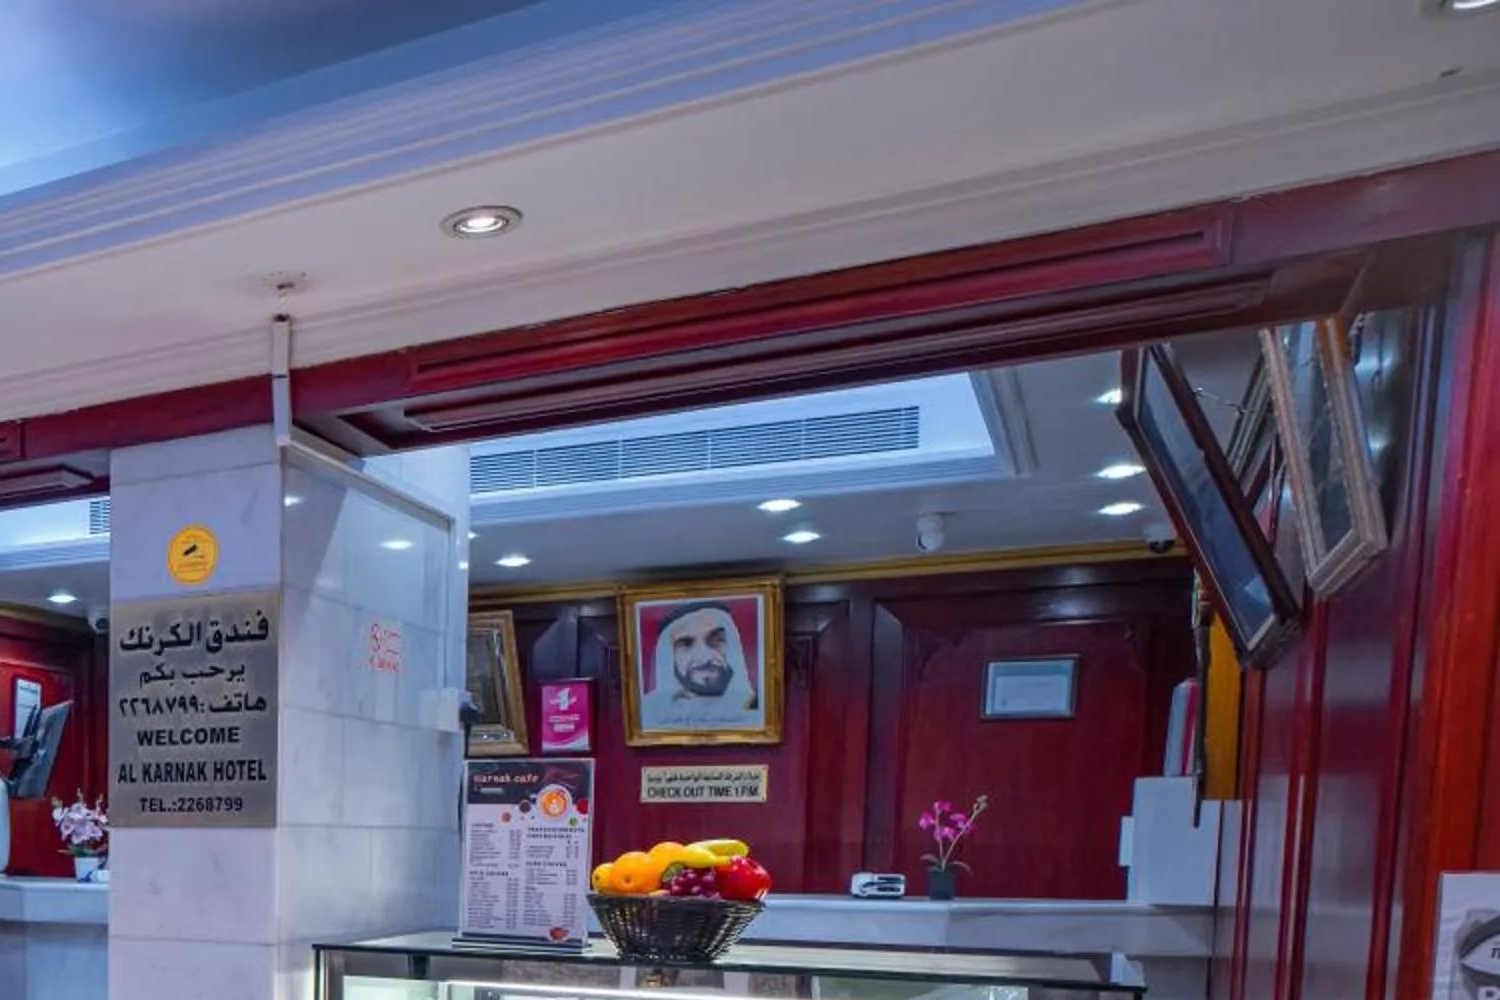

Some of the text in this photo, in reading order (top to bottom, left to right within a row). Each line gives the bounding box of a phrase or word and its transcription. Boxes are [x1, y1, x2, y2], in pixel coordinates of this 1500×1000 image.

[119, 609, 269, 656] فندق الكرنك
[139, 662, 175, 689] بكم
[137, 726, 241, 748] WELCOME
[117, 758, 267, 785] AL KARNAK HOTEL
[647, 786, 680, 798] CHECK
[683, 786, 705, 797] OUT
[708, 785, 732, 797] TIME
